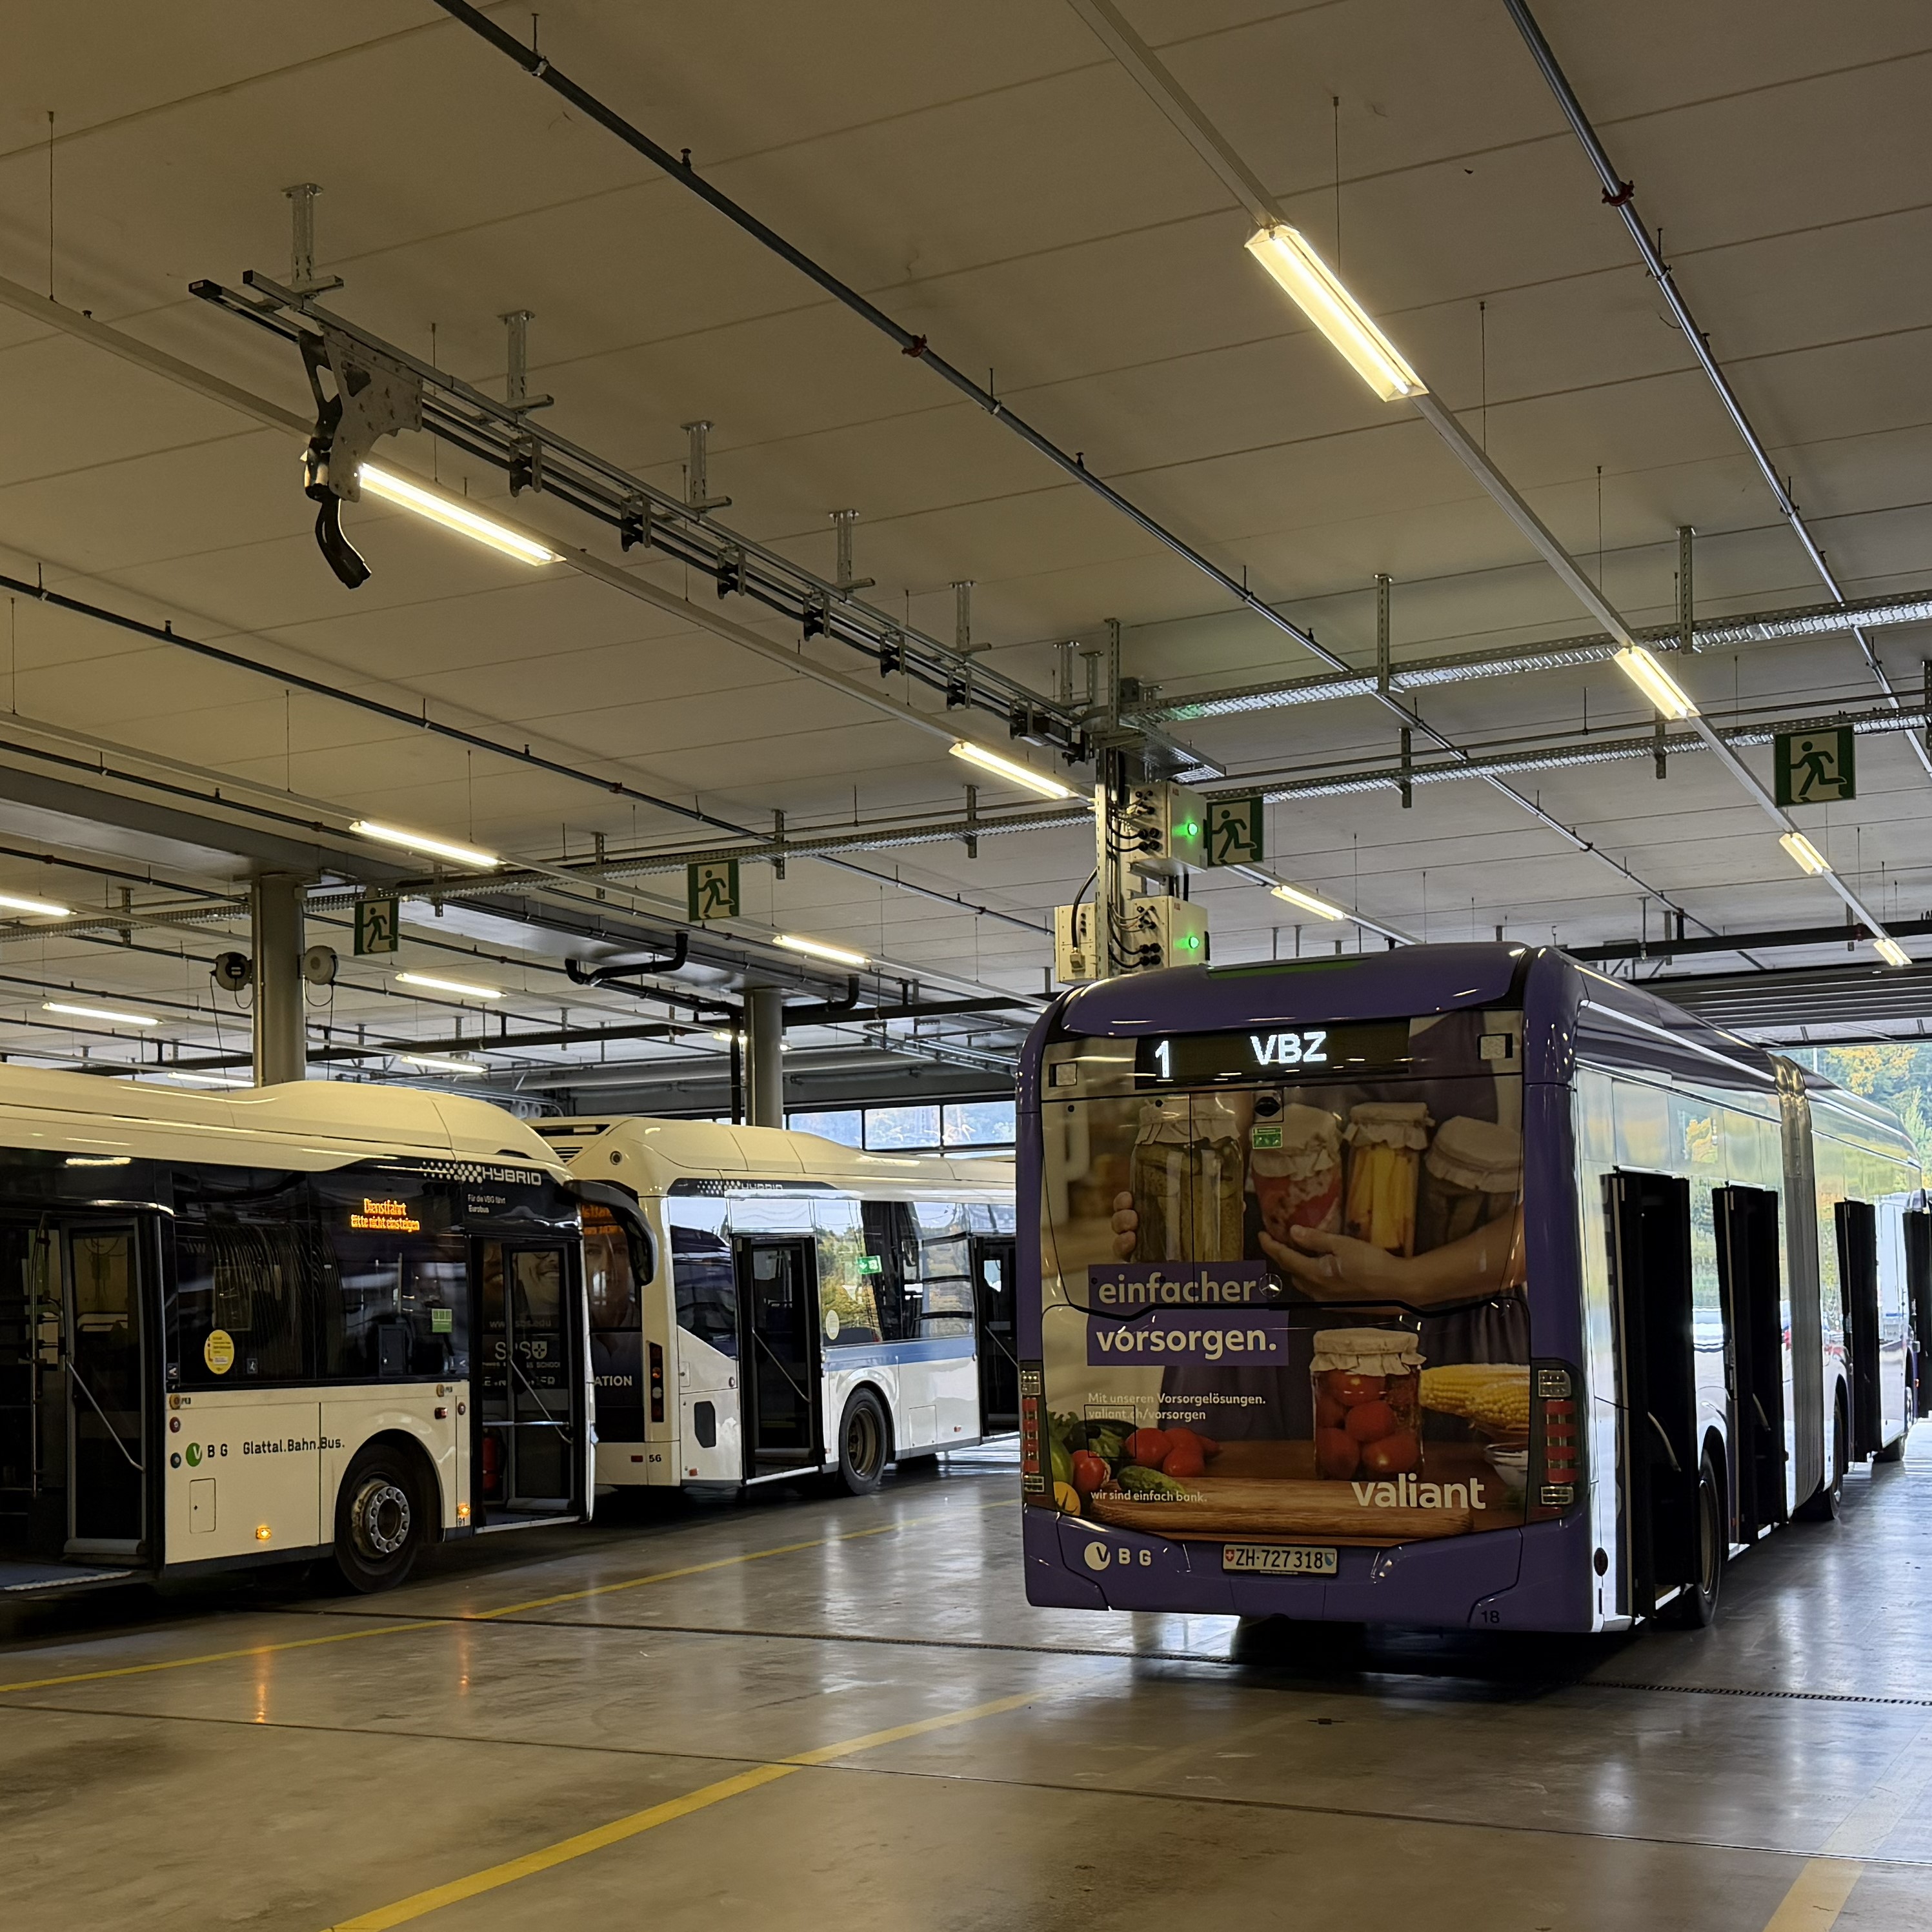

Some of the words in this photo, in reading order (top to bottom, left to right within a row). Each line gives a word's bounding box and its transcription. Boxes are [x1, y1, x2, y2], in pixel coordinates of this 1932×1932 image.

[1155, 1040, 1169, 1078] 1
[1250, 1031, 1327, 1065] VBZ
[482, 1166, 541, 1185] HYBRID
[364, 1198, 407, 1216] Dienstfahrt
[1099, 1271, 1257, 1303] einfacher
[1096, 1329, 1277, 1360] vorsorgen.
[1089, 1393, 1107, 1404] Mit
[1110, 1394, 1154, 1404] unseren
[1157, 1393, 1266, 1407] Vorsorgelösungen.
[1088, 1407, 1207, 1422] valiant.ch/vorsorgen
[649, 1454, 662, 1463] 56
[1091, 1489, 1107, 1500] wir
[1109, 1490, 1131, 1500] sind
[1133, 1490, 1174, 1501] einfach
[1176, 1491, 1208, 1502] bank.
[1351, 1473, 1486, 1509] valiant
[1481, 1610, 1500, 1624] 18
